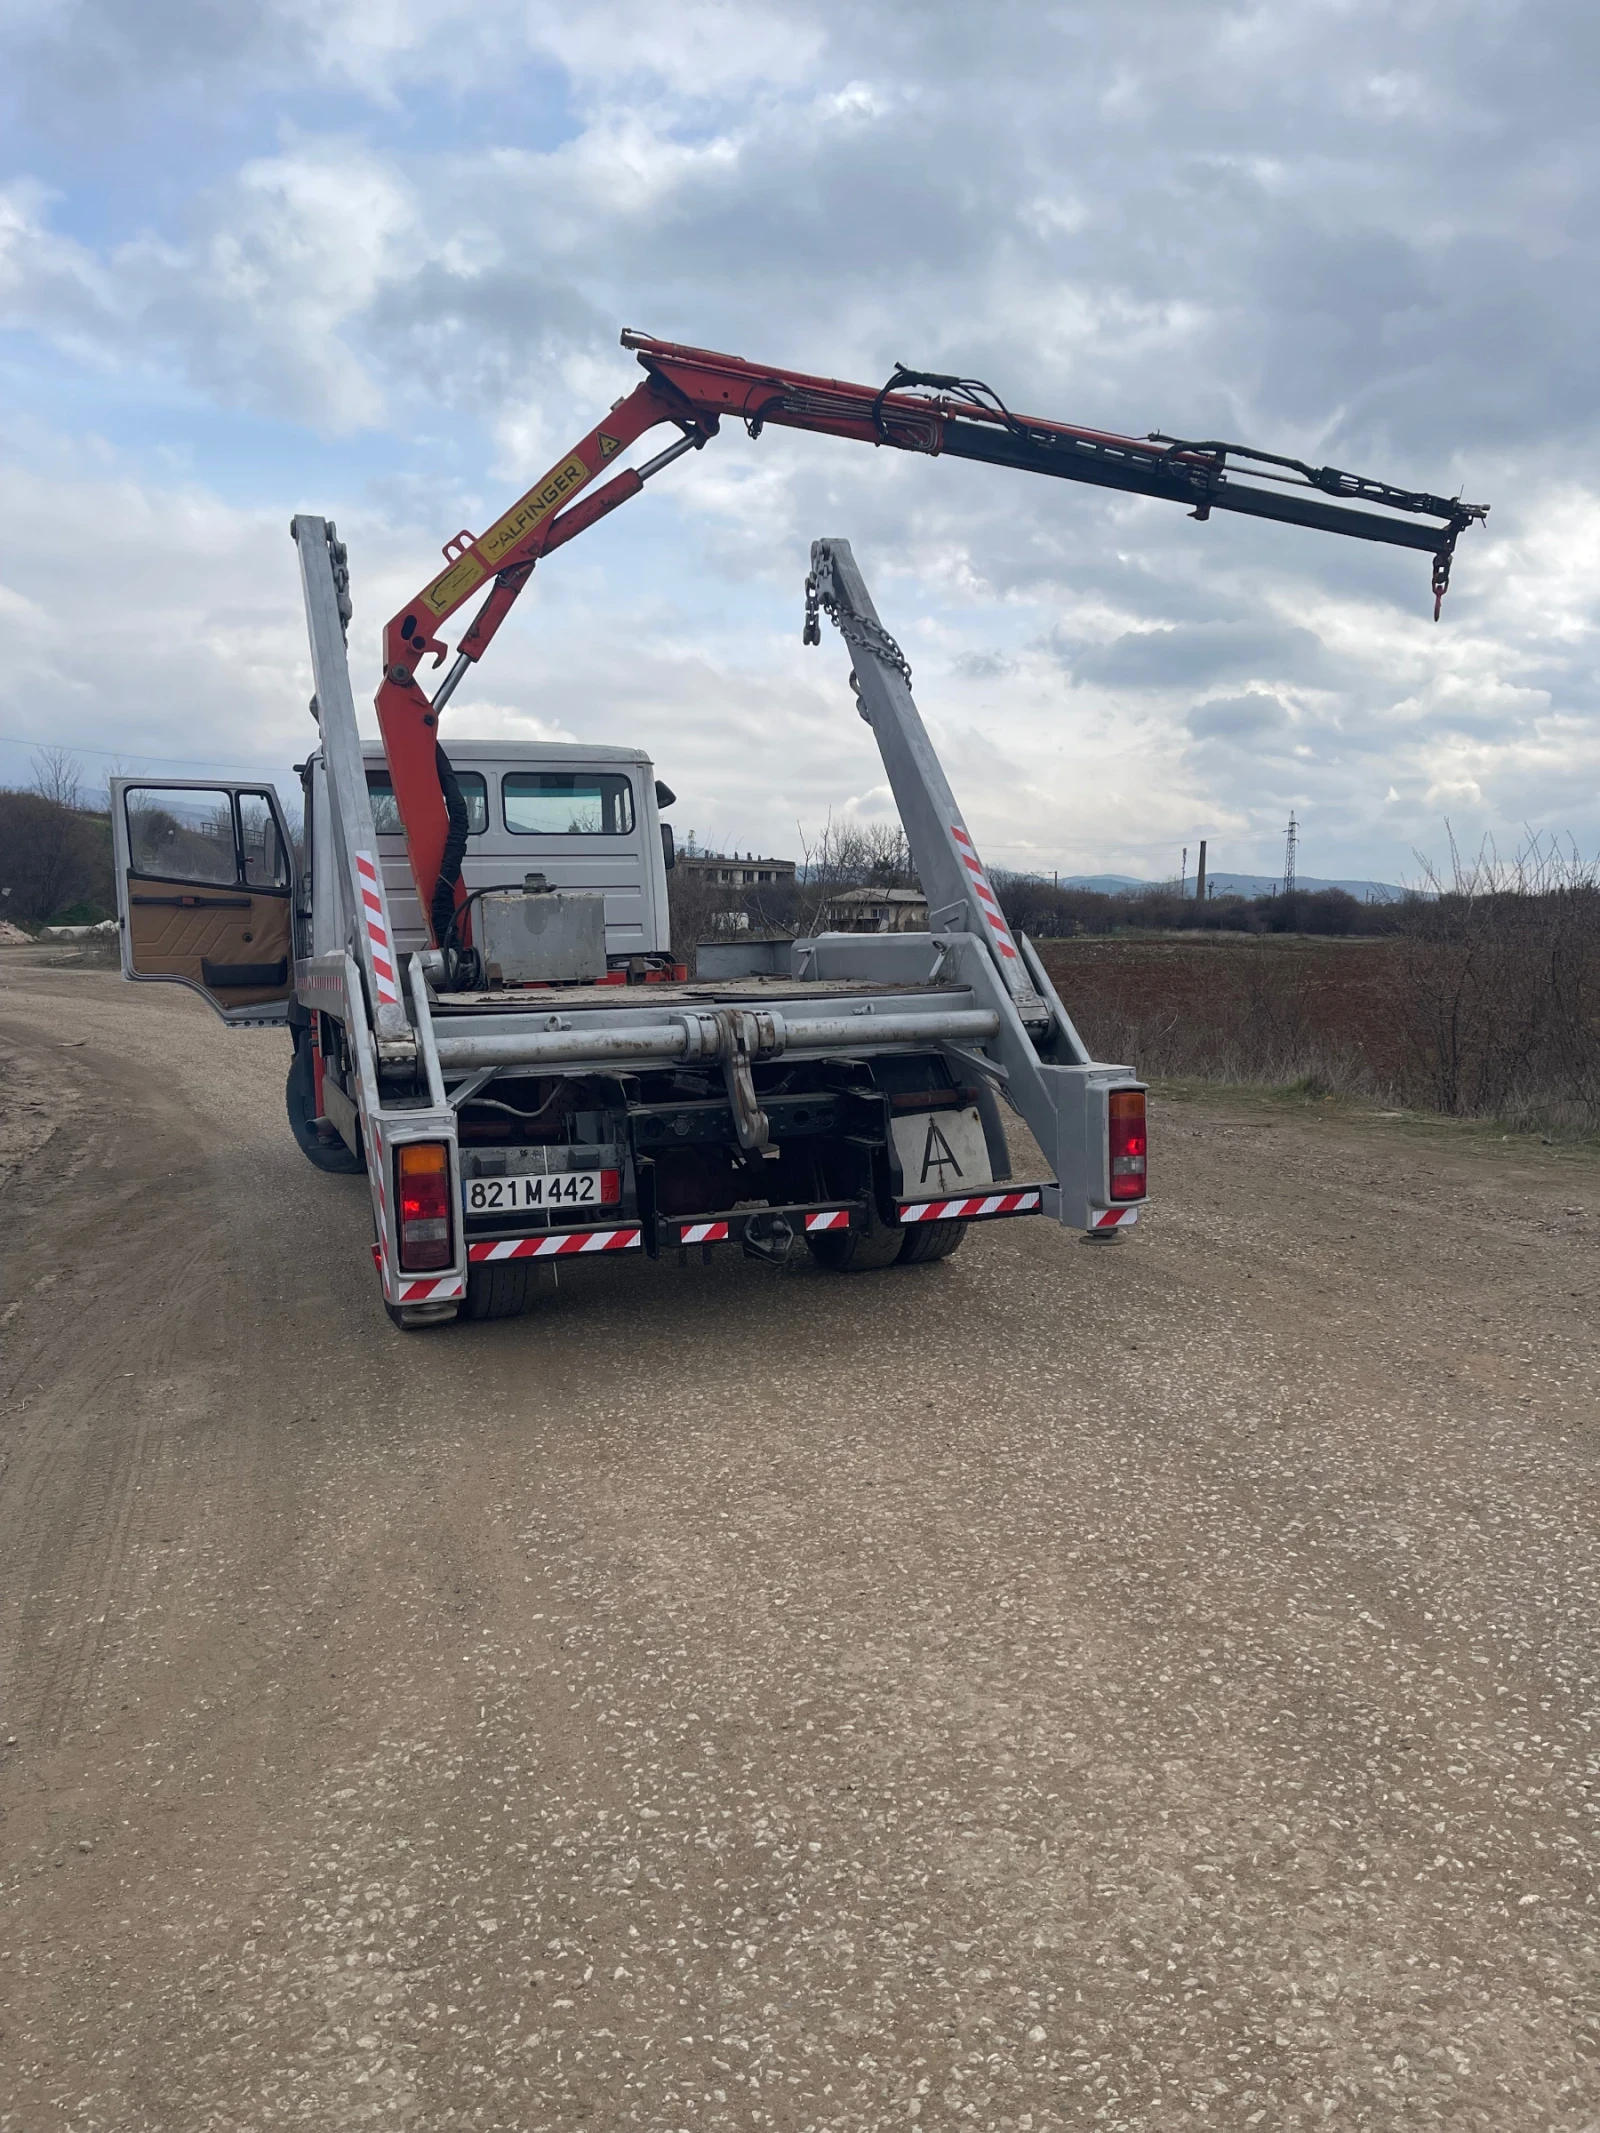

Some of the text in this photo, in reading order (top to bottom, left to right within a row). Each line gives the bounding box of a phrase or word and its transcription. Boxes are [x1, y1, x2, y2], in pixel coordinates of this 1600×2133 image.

[920, 1125, 963, 1183] A
[471, 1176, 594, 1208] 821 M 442
